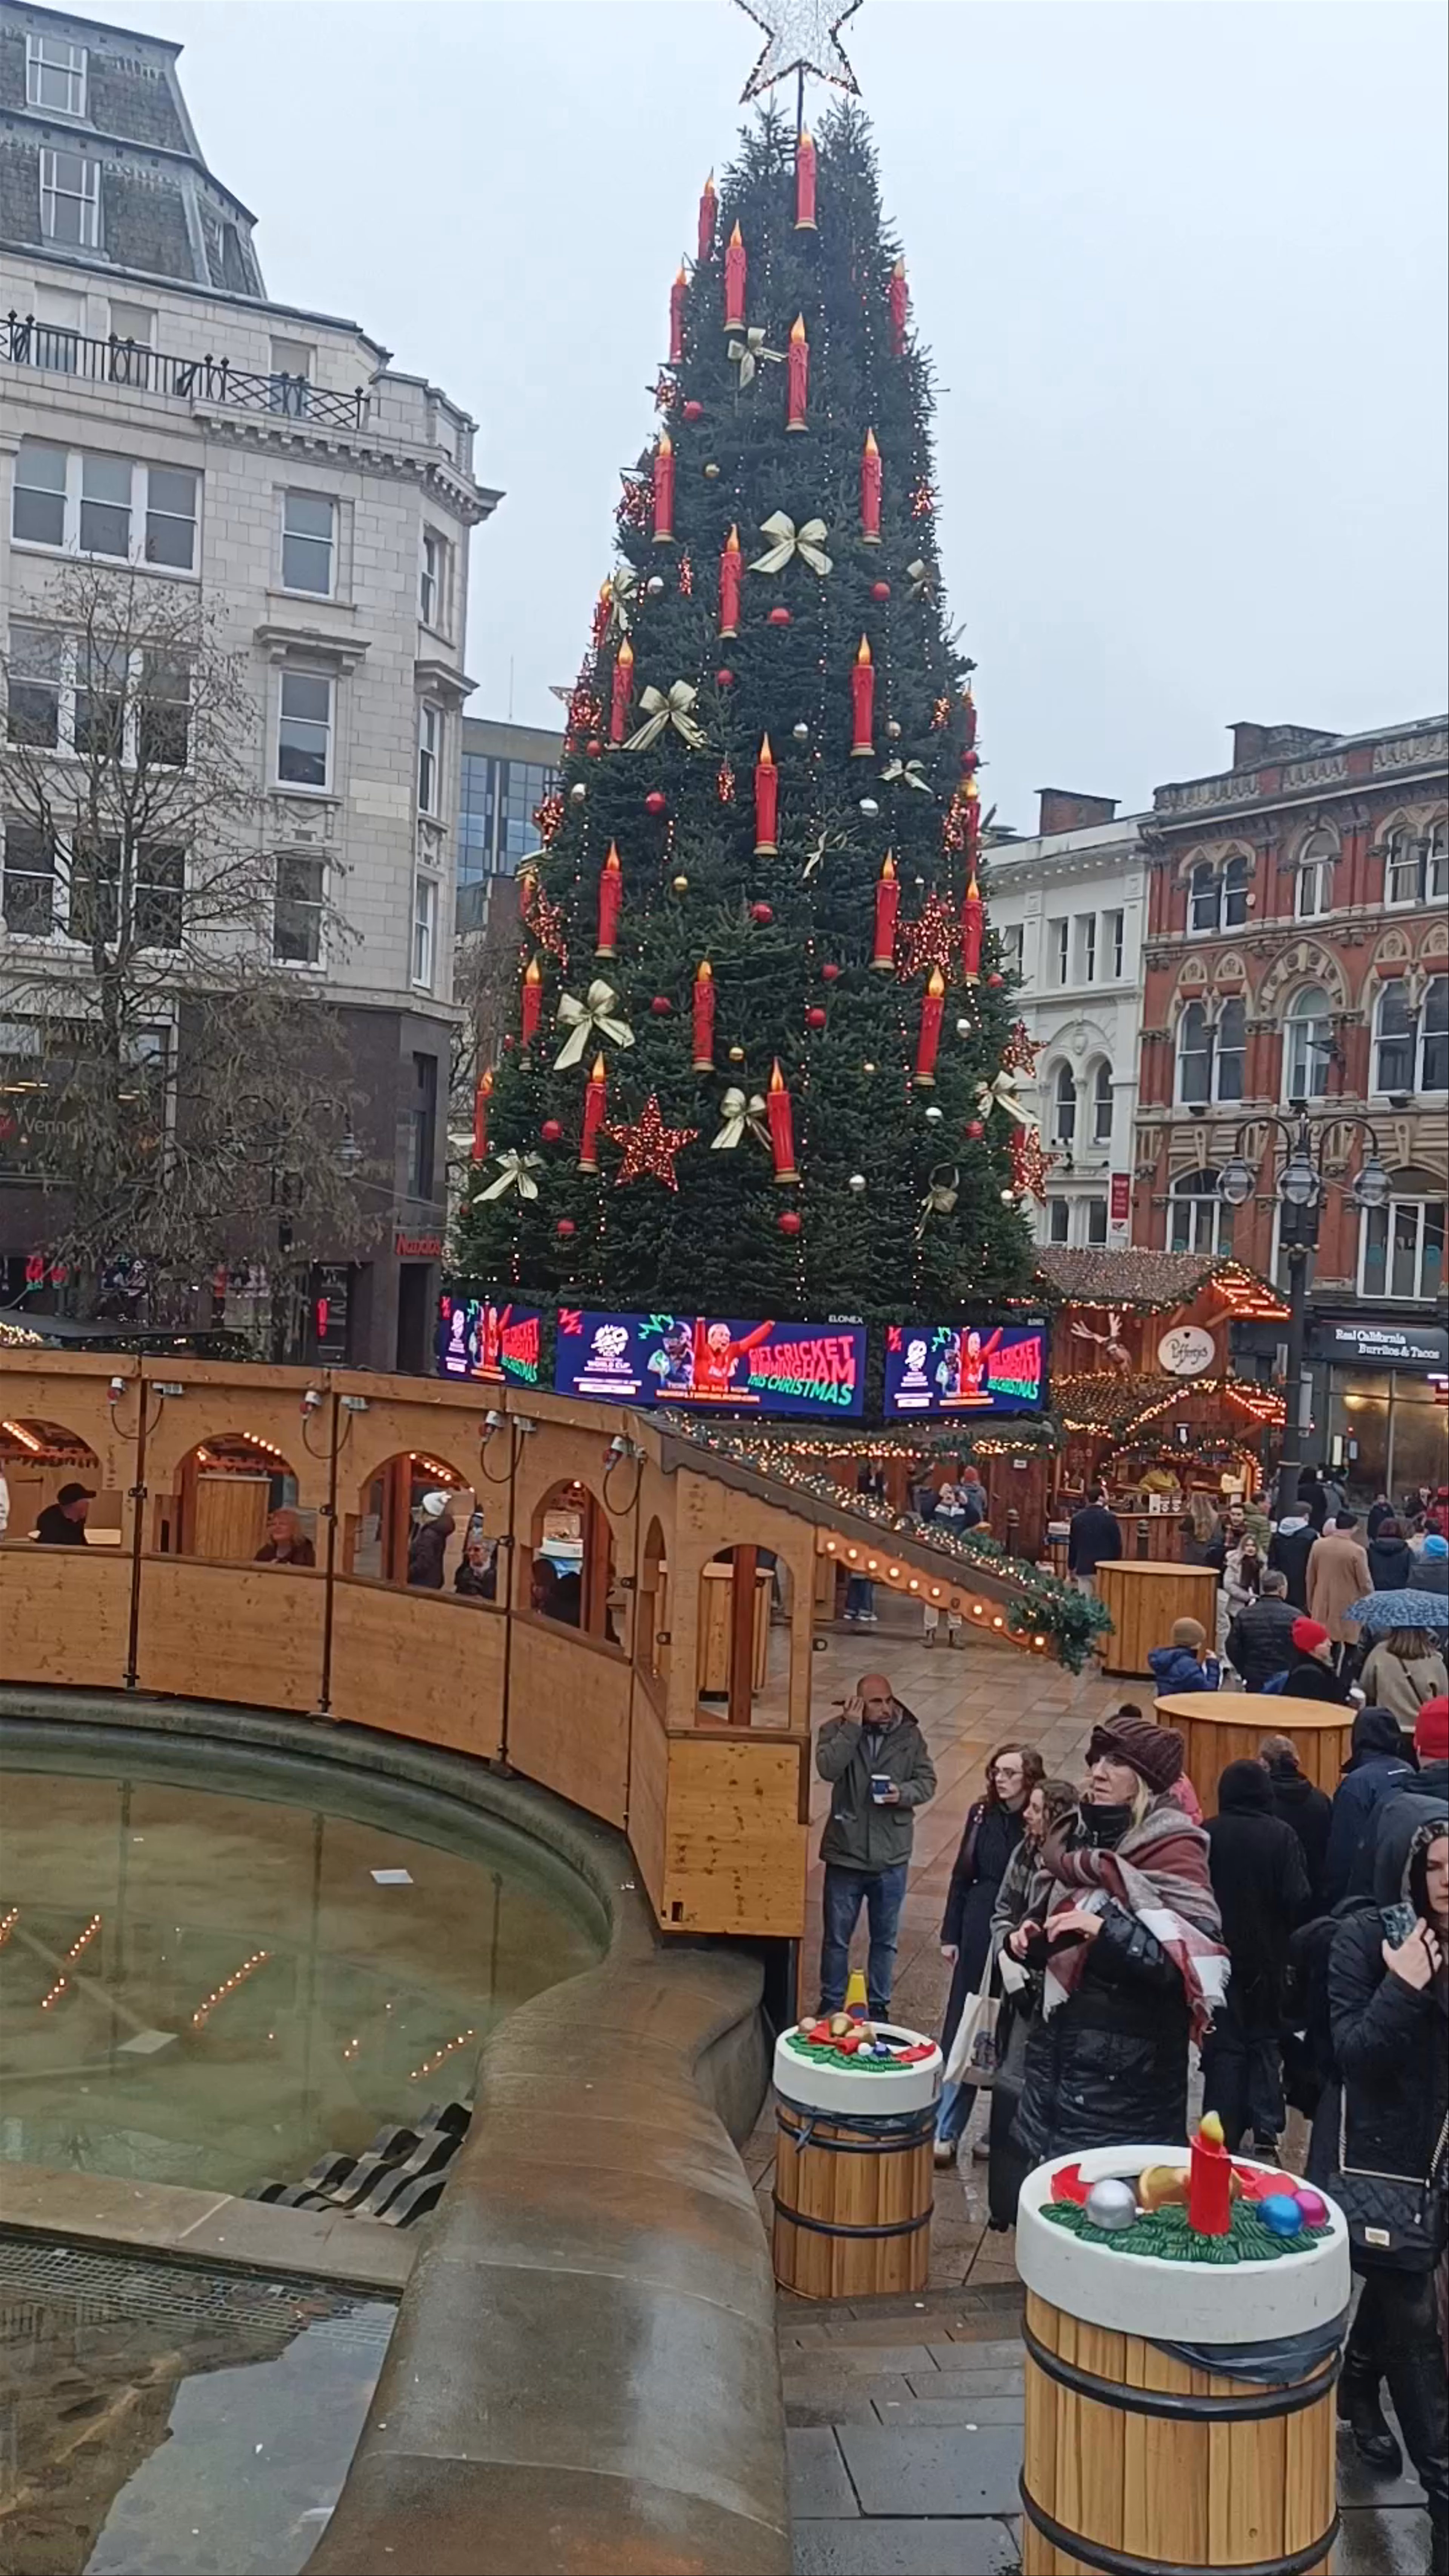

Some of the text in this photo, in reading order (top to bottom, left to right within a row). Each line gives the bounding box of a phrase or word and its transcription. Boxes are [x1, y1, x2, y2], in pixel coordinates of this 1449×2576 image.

[828, 1315, 864, 1324] ELONEX
[1335, 1329, 1406, 1344] Real California
[749, 1335, 854, 1361] GIFT CRICKET
[1358, 1343, 1399, 1356] Burritos
[1410, 1346, 1440, 1359] Tacos
[768, 1375, 855, 1406] CHRISTMAS
